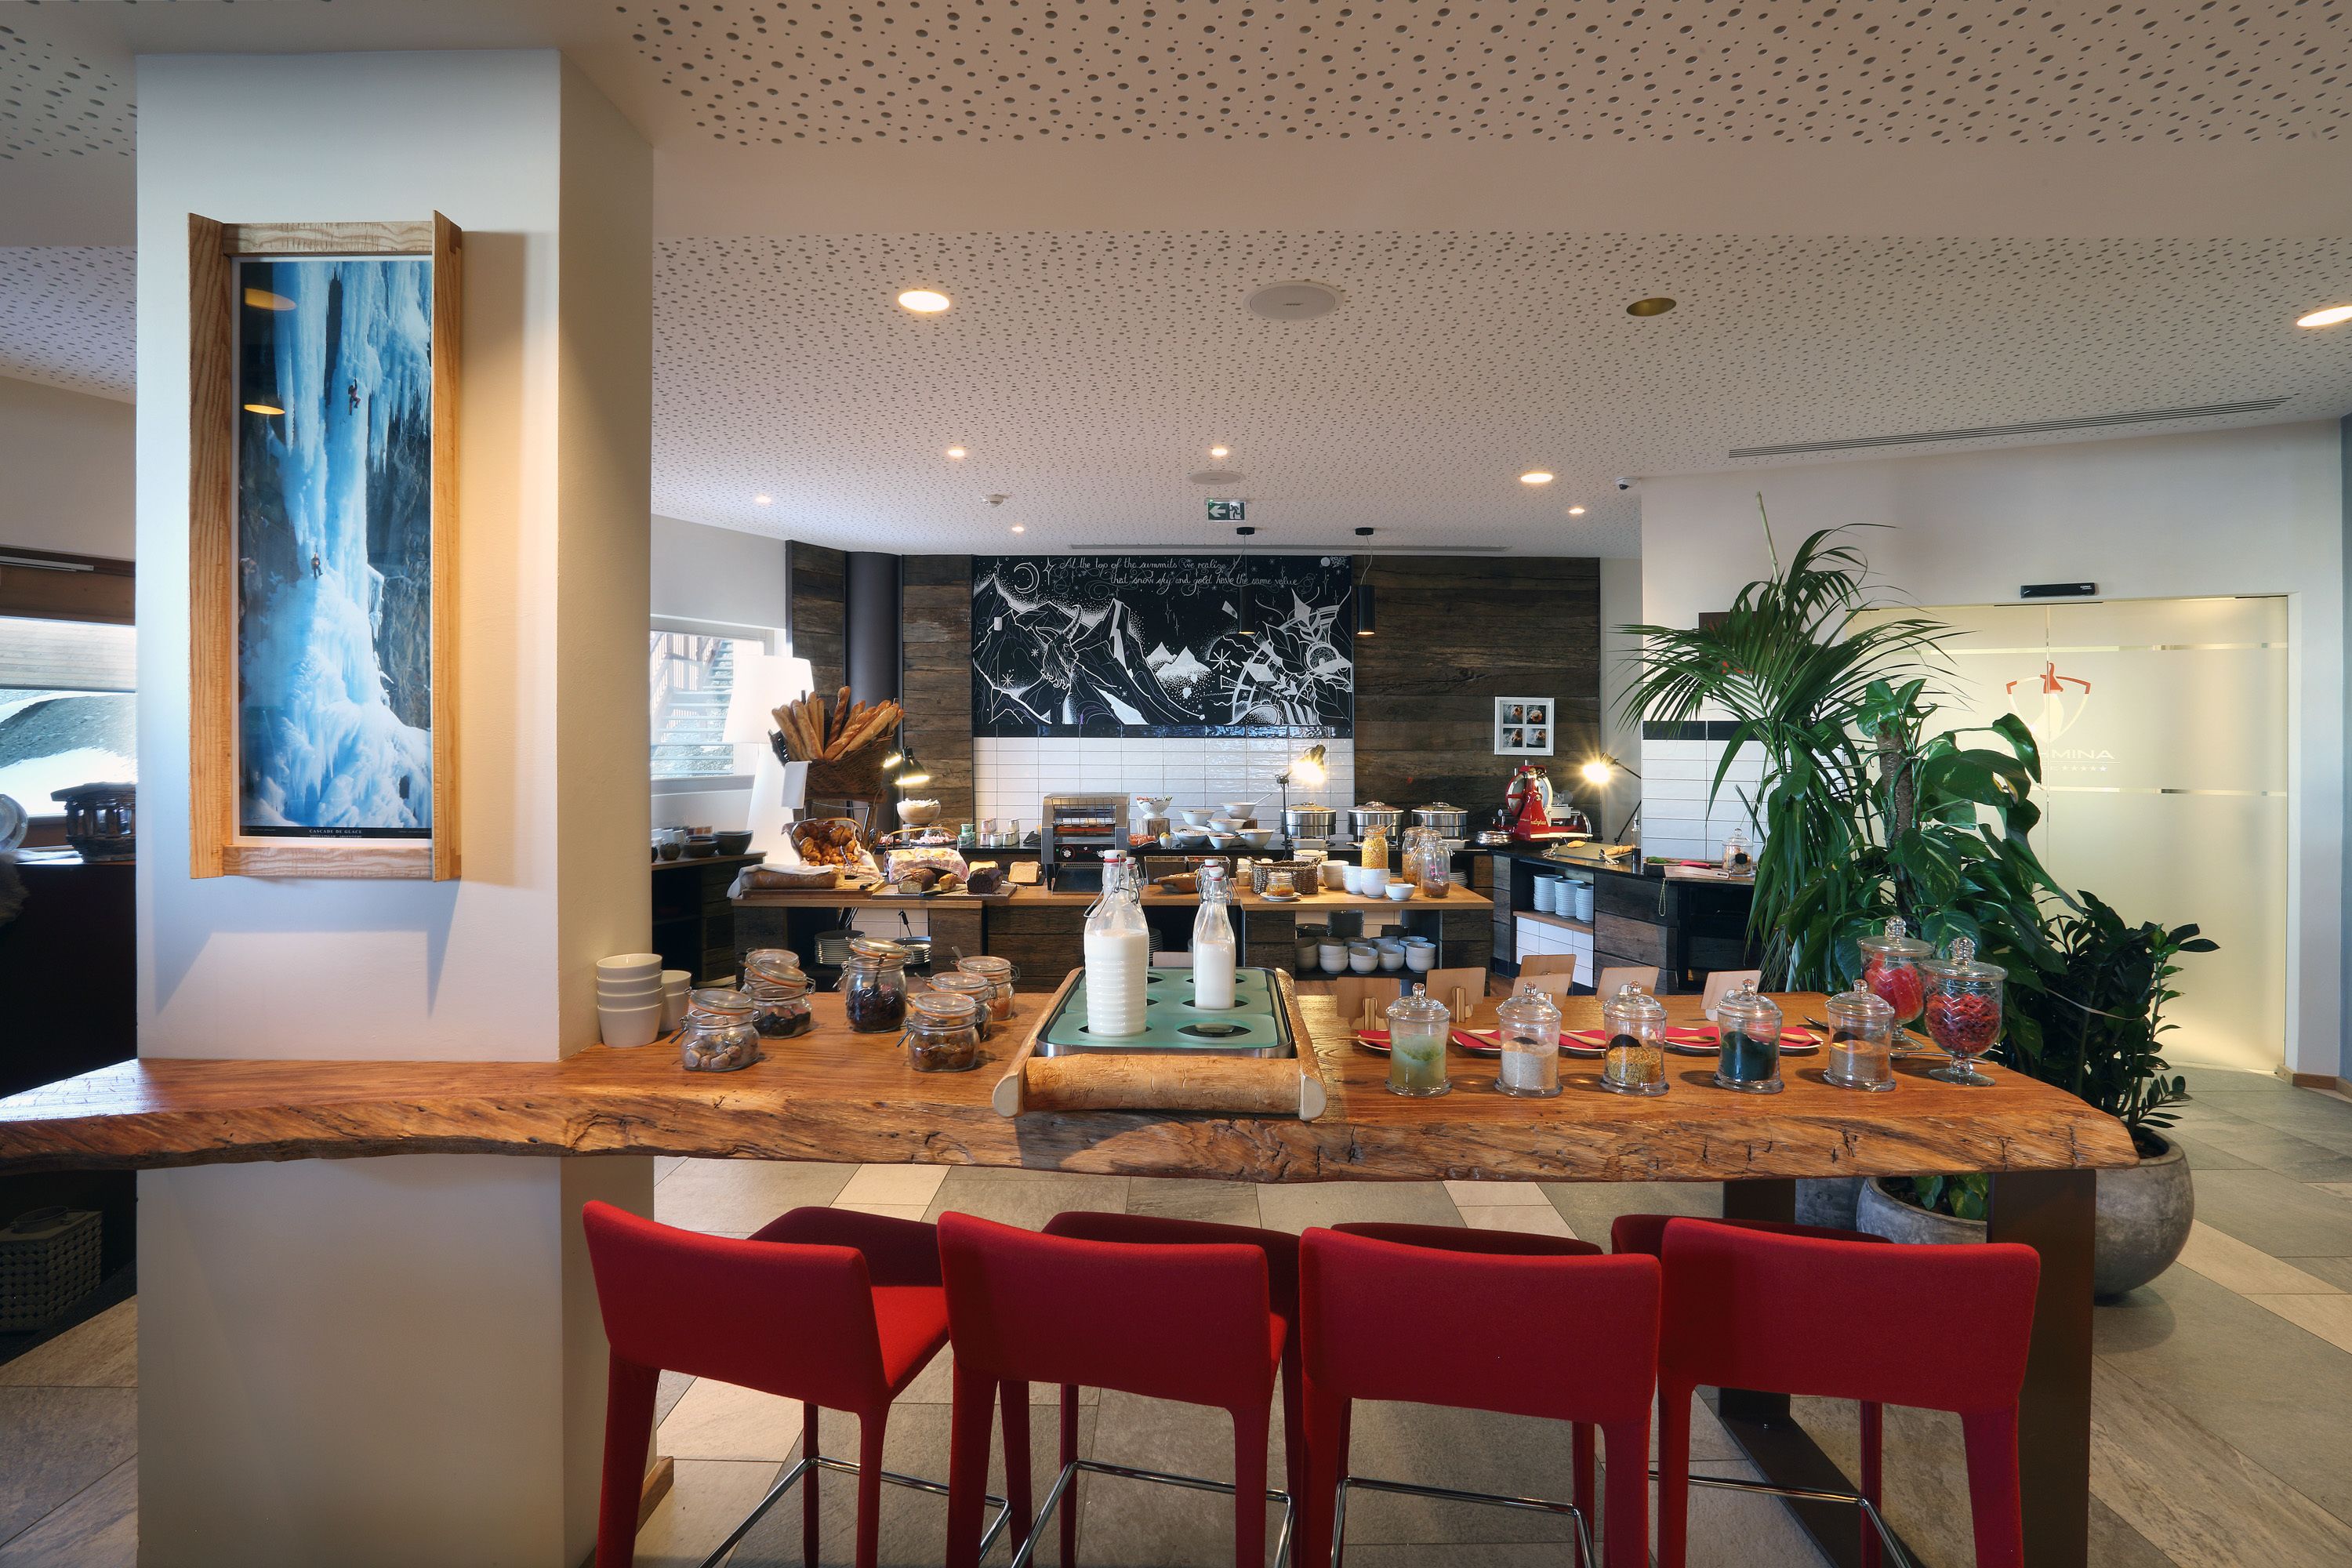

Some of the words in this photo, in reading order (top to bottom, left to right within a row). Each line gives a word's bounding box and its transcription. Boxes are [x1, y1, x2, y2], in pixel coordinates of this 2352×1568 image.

[1080, 557, 1091, 568] the
[1096, 557, 1109, 577] top
[1111, 558, 1122, 574] of
[1124, 558, 1137, 568] the
[1138, 558, 1178, 568] summits
[1198, 559, 1226, 574] realize
[1110, 573, 1129, 584] that
[1156, 572, 1171, 594] sky
[1175, 574, 1190, 584] and
[1216, 574, 1234, 584] have
[1236, 574, 1248, 584] the
